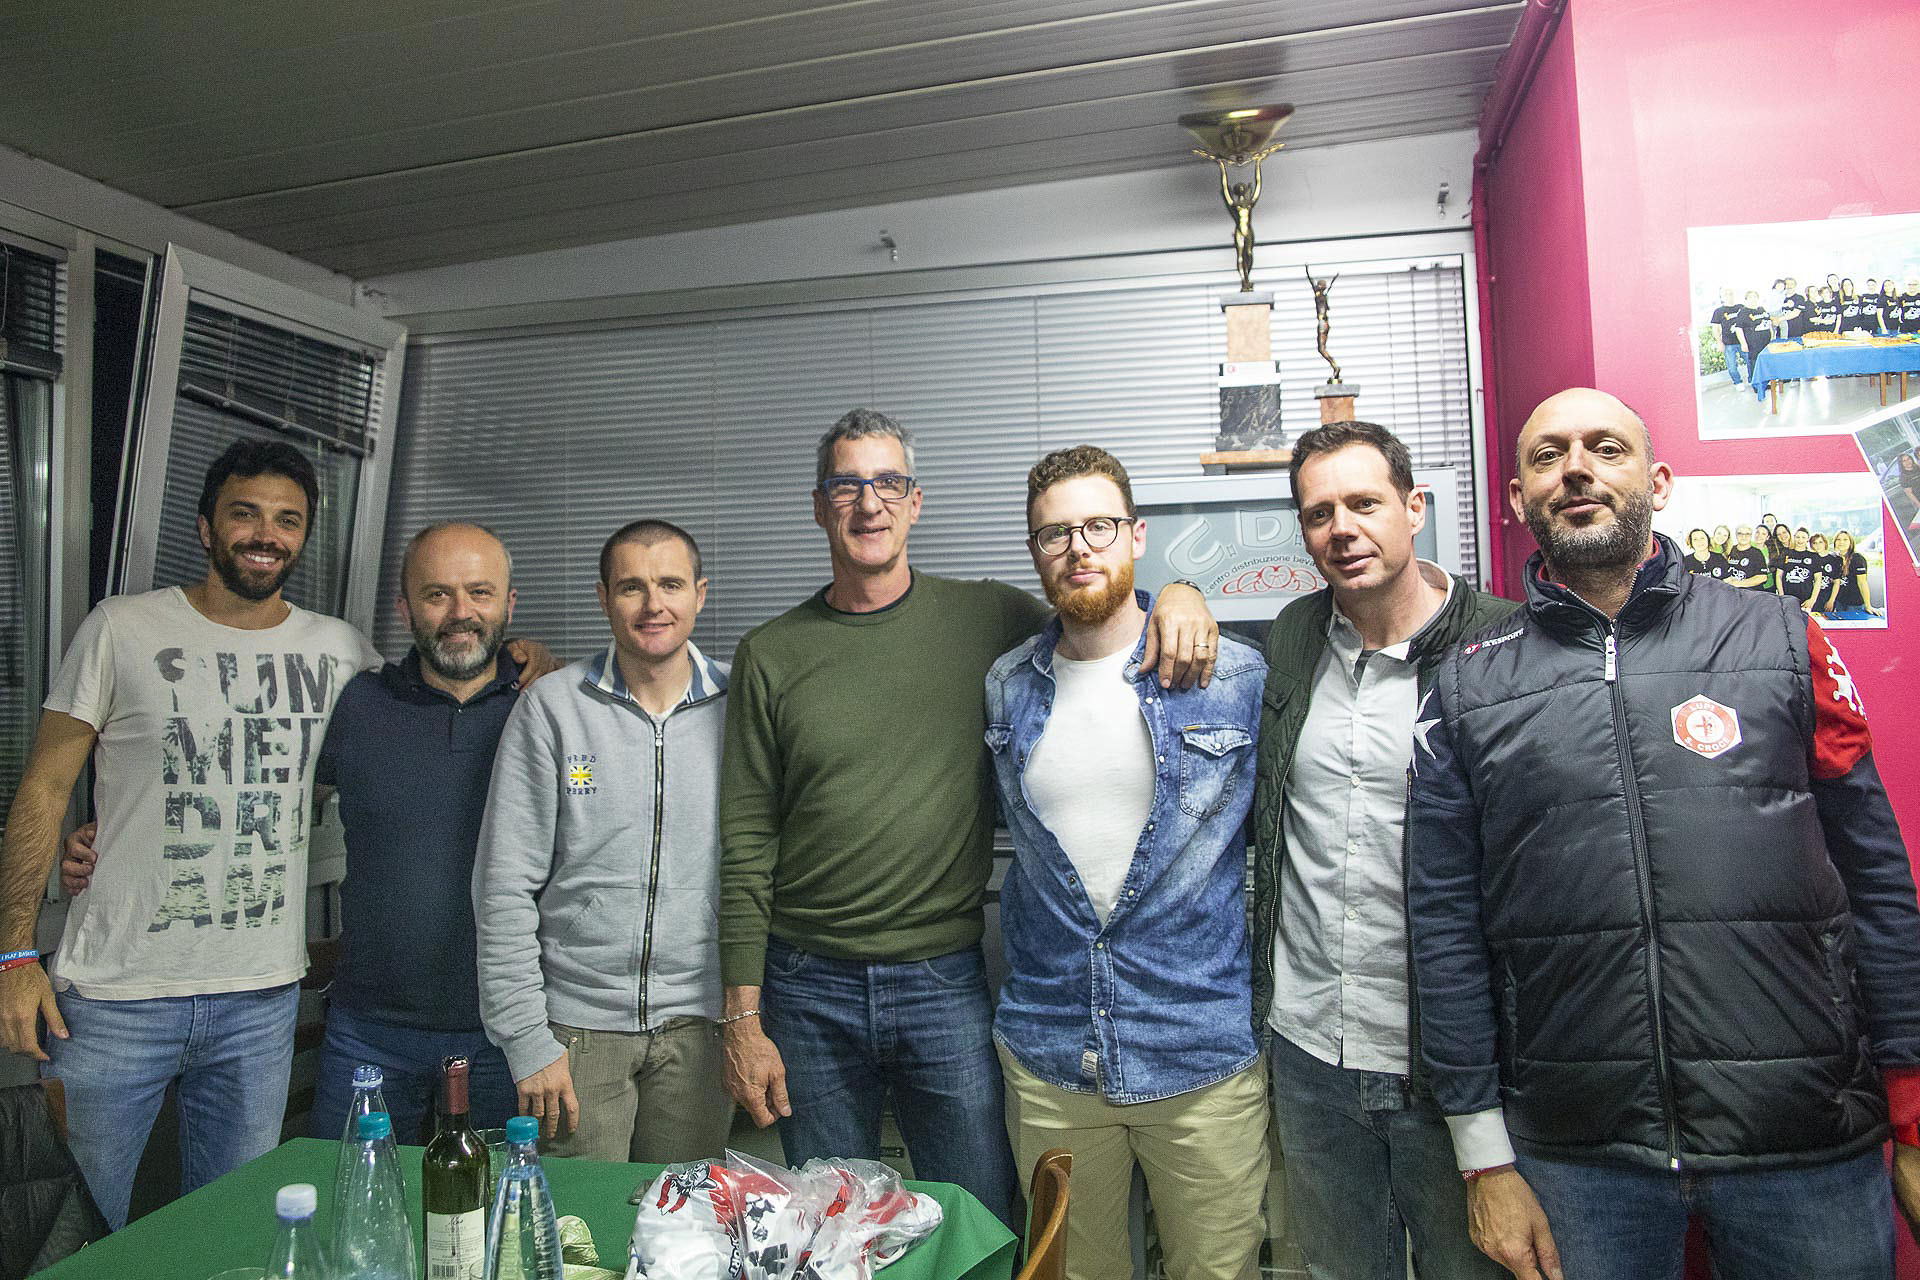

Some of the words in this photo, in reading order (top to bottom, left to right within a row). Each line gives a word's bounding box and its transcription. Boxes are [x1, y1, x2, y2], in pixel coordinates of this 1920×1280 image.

[1205, 572, 1230, 594] centro
[1231, 555, 1290, 573] distribuzione
[1688, 703, 1715, 712] LUPI
